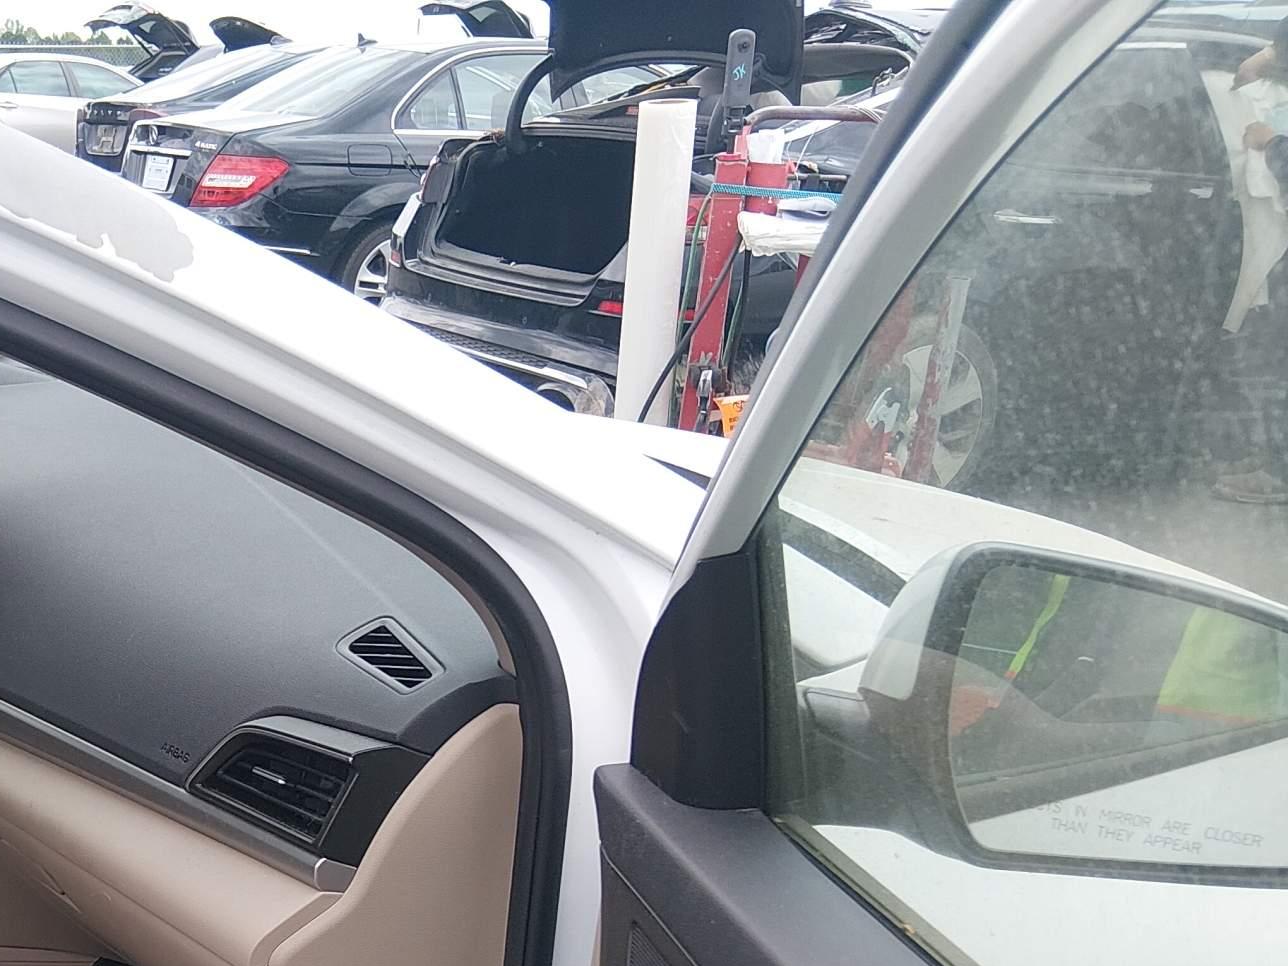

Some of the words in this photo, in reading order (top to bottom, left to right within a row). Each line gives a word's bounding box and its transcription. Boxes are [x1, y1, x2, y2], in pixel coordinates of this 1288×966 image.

[1051, 818, 1089, 835] THAN
[1097, 825, 1135, 842] THEY
[1143, 834, 1203, 855] APPEAR
[1099, 809, 1153, 830] MIRROR
[1161, 820, 1192, 837] ARE
[1204, 827, 1265, 848] CLOSER
